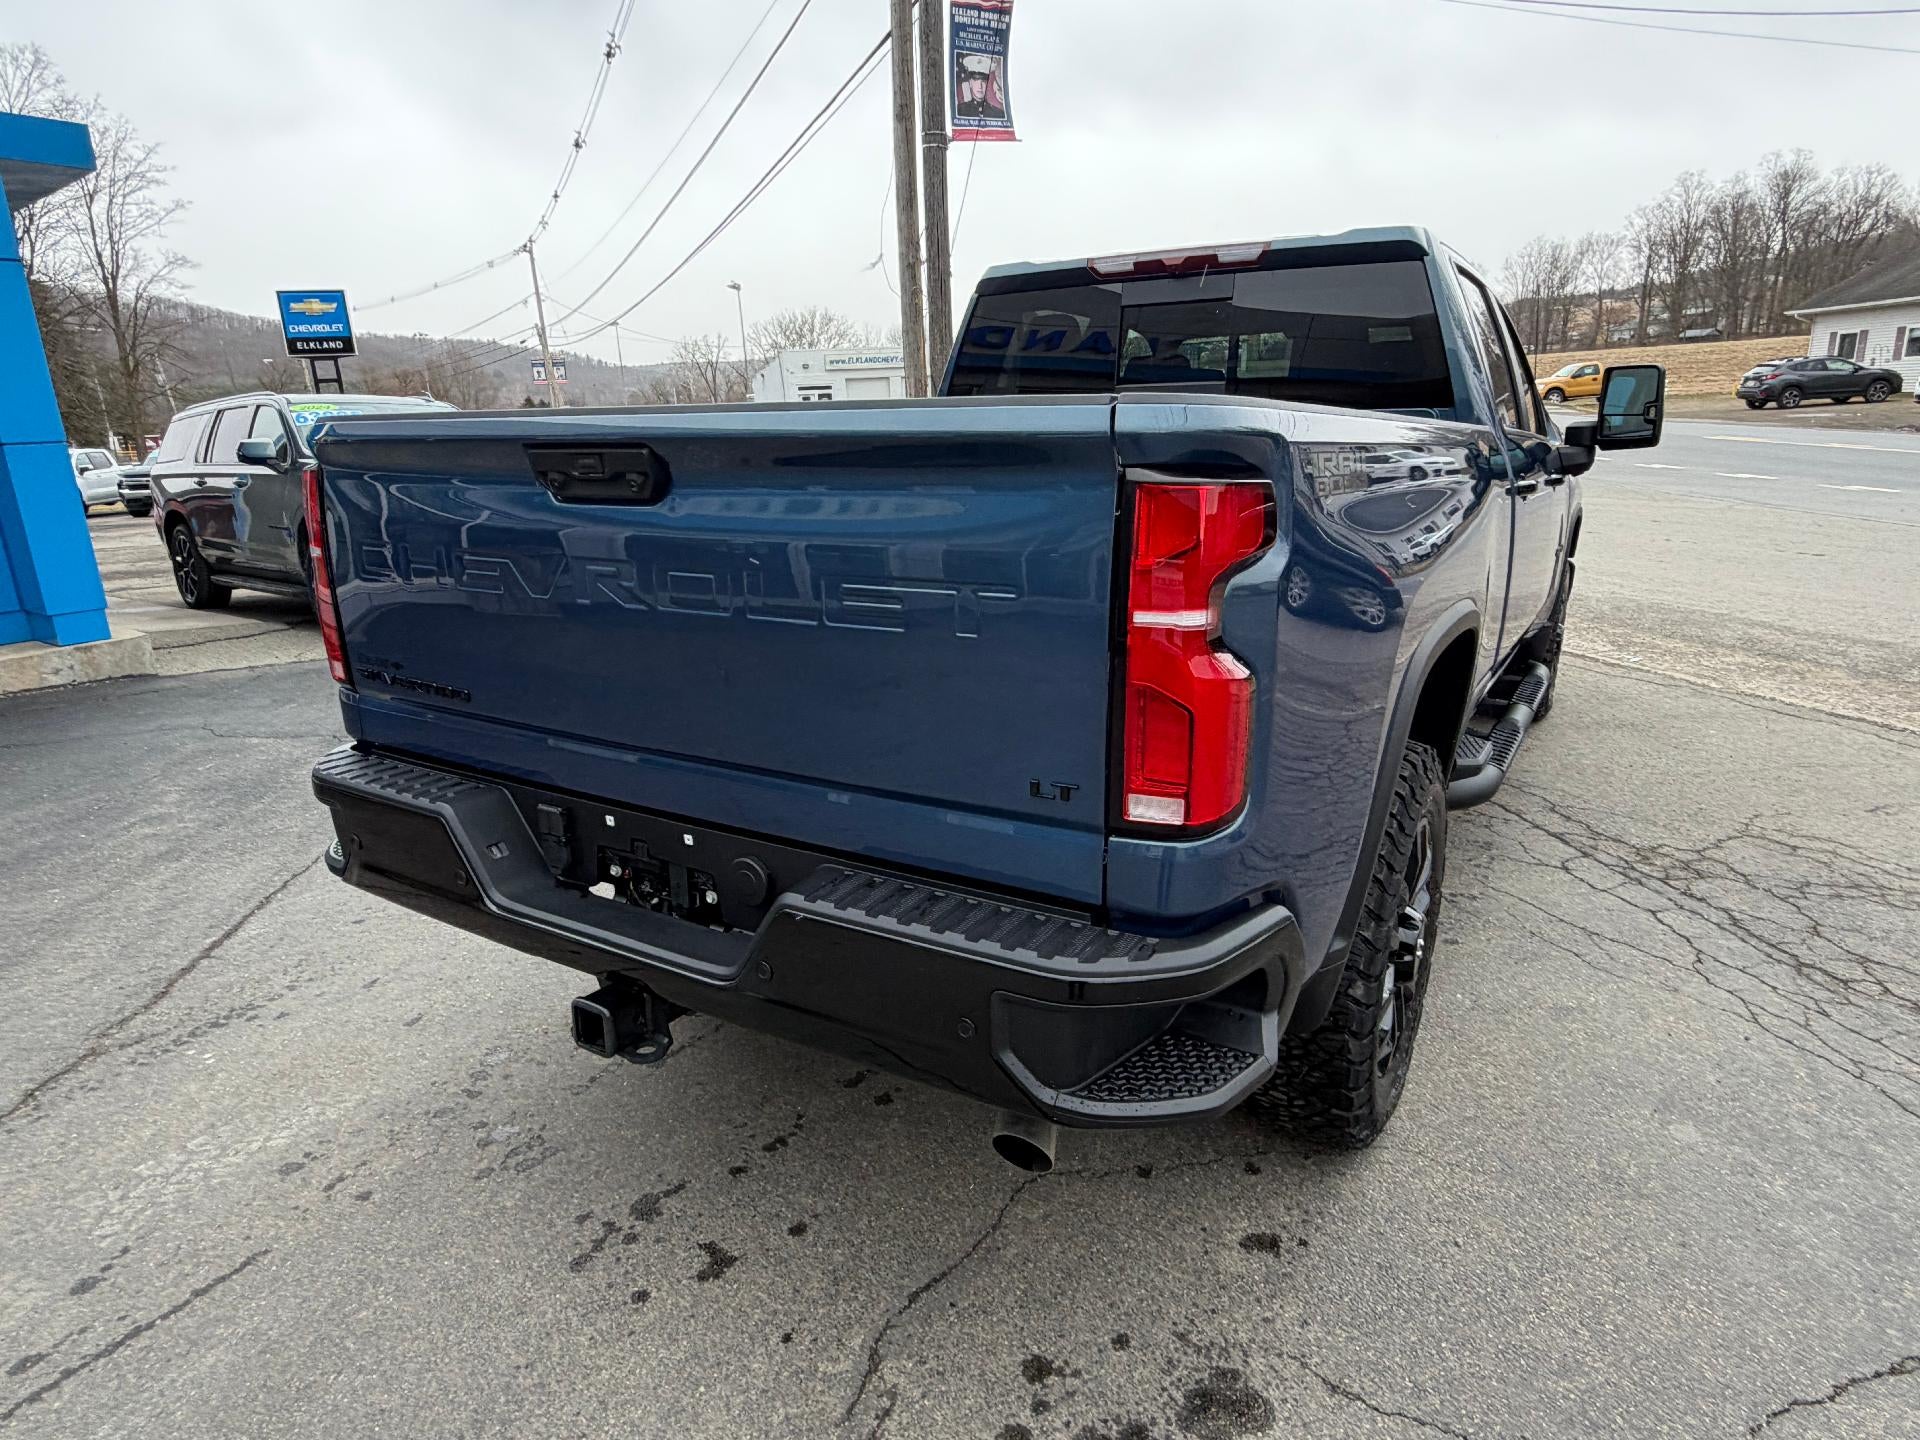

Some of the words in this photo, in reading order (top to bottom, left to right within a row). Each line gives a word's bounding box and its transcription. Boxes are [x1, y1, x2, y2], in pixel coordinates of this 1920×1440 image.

[289, 323, 344, 333] CHEVROLET
[296, 340, 344, 350] ELKLAND
[358, 540, 1020, 639] CHEVROLET
[1029, 778, 1080, 802] LT
